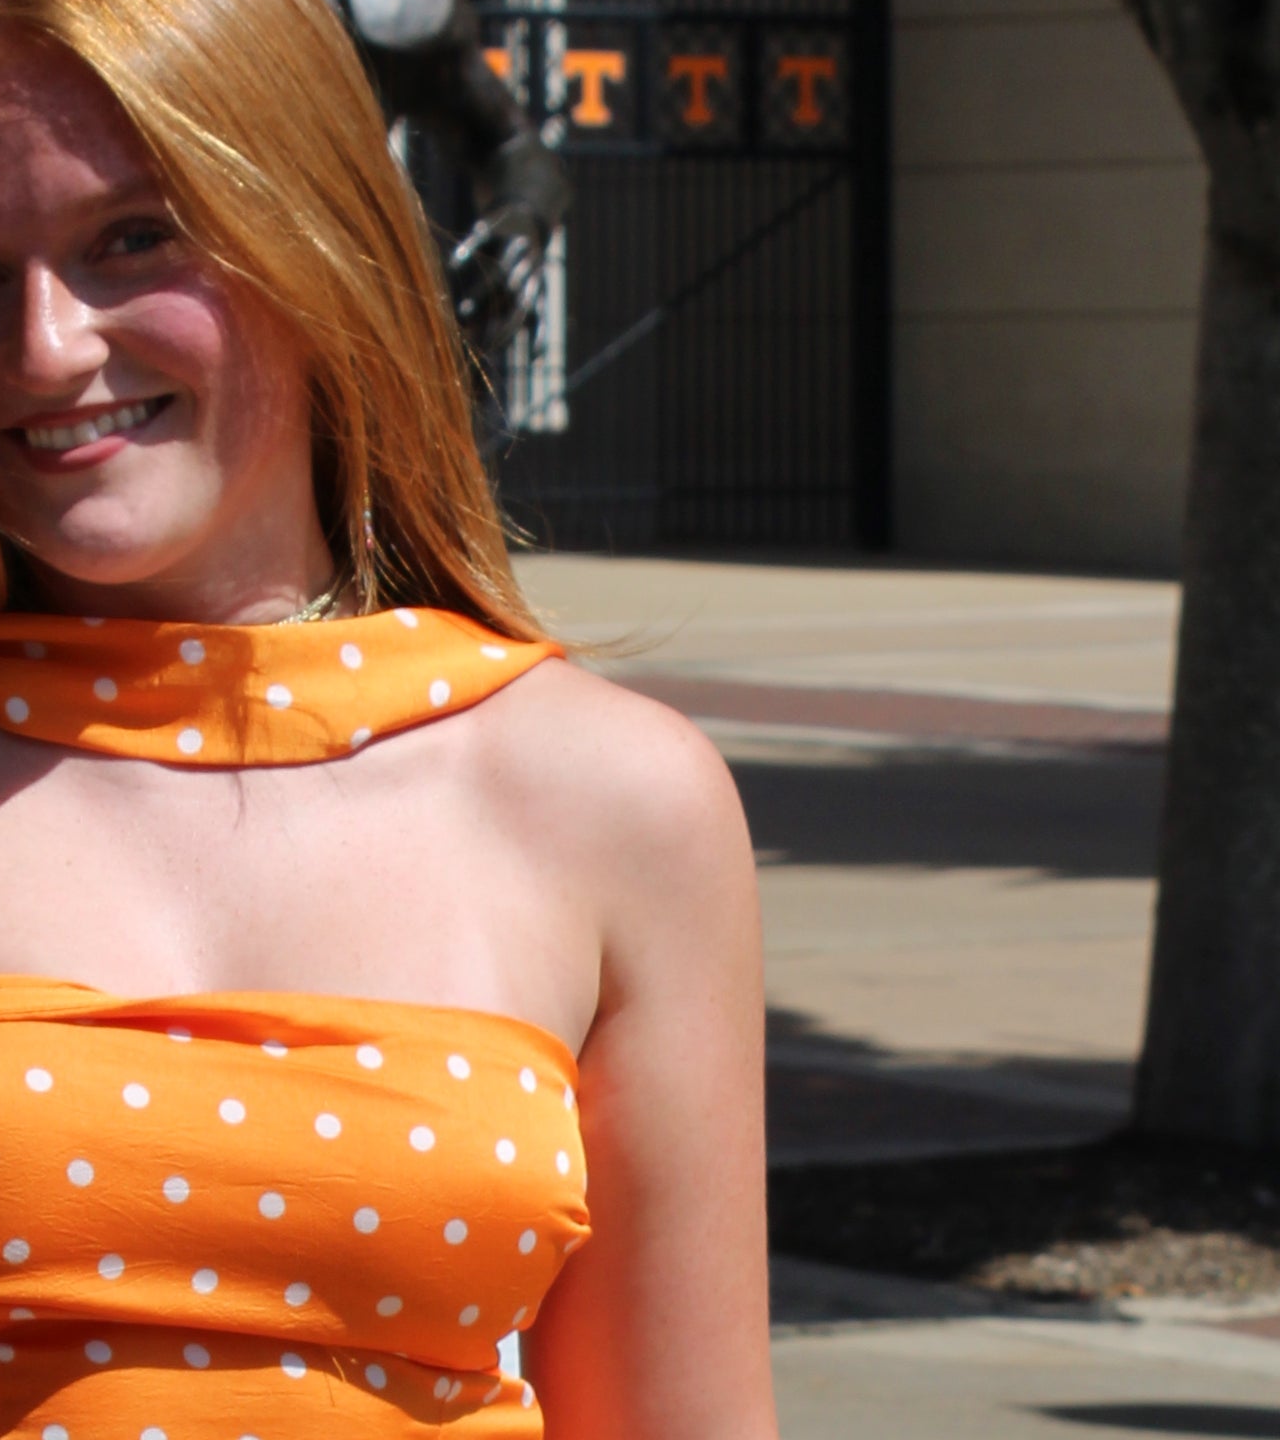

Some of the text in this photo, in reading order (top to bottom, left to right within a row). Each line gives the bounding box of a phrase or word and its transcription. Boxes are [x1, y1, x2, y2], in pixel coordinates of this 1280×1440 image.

[563, 50, 625, 126] T
[670, 56, 727, 124] T
[778, 56, 836, 124] T
